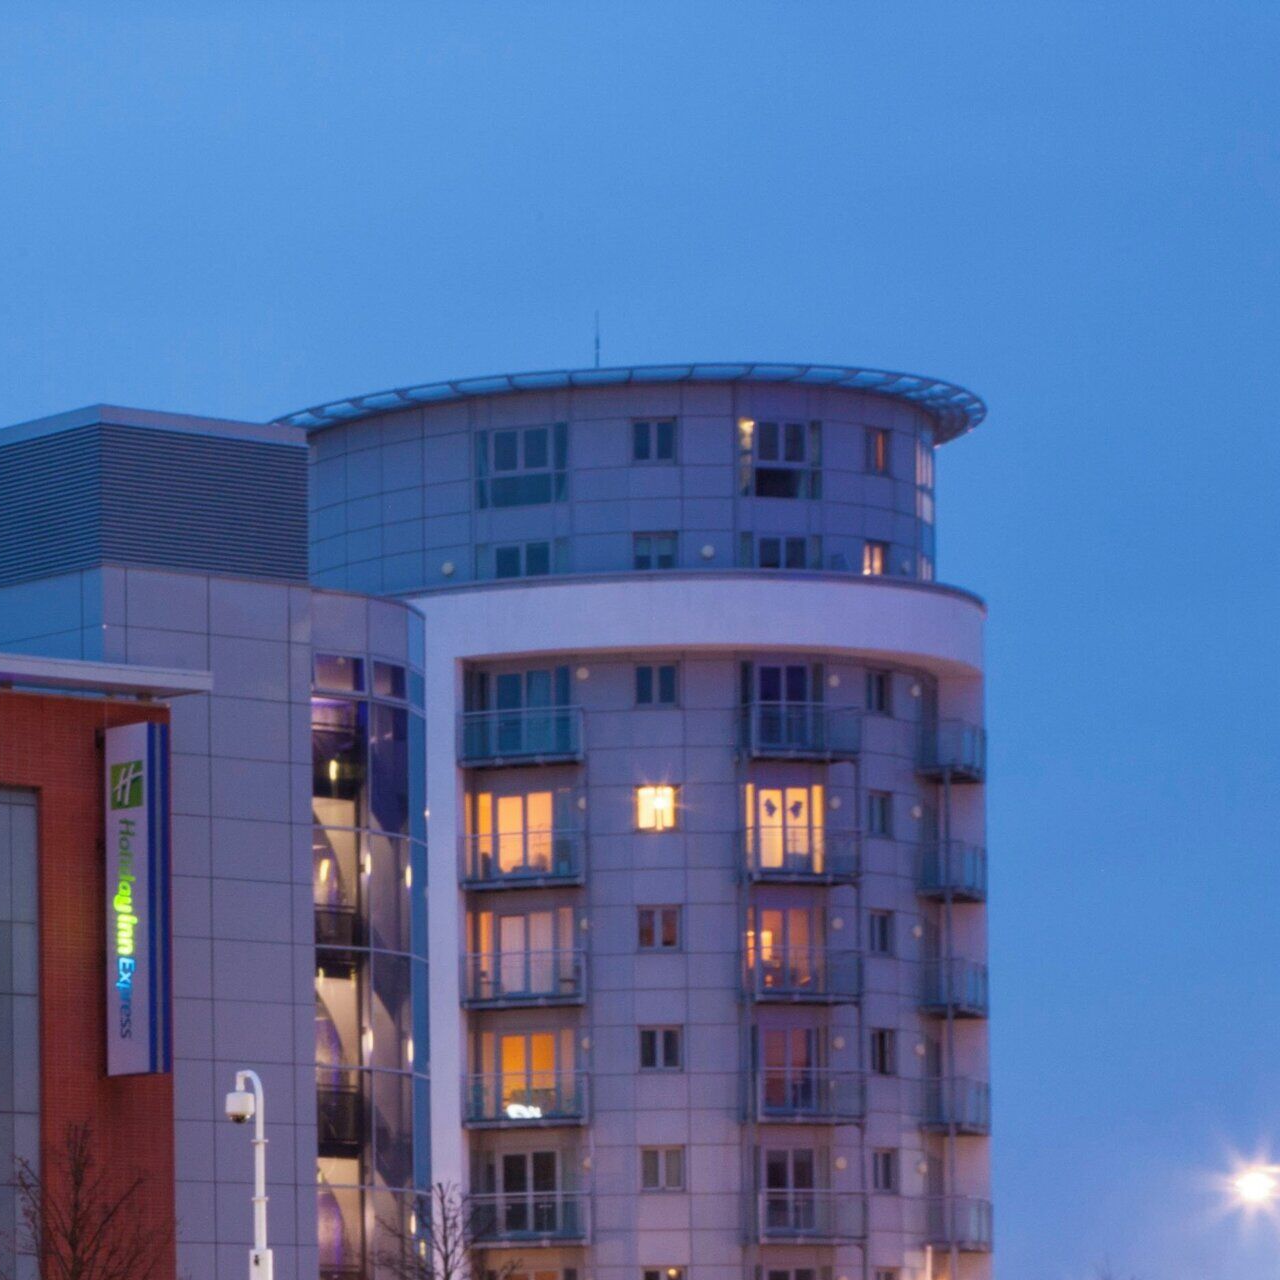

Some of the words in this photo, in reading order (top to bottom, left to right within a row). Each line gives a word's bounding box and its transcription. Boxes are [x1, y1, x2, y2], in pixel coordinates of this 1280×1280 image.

[113, 818, 137, 912] Holiday
[116, 913, 138, 956] Inn
[114, 957, 136, 1040] Express
